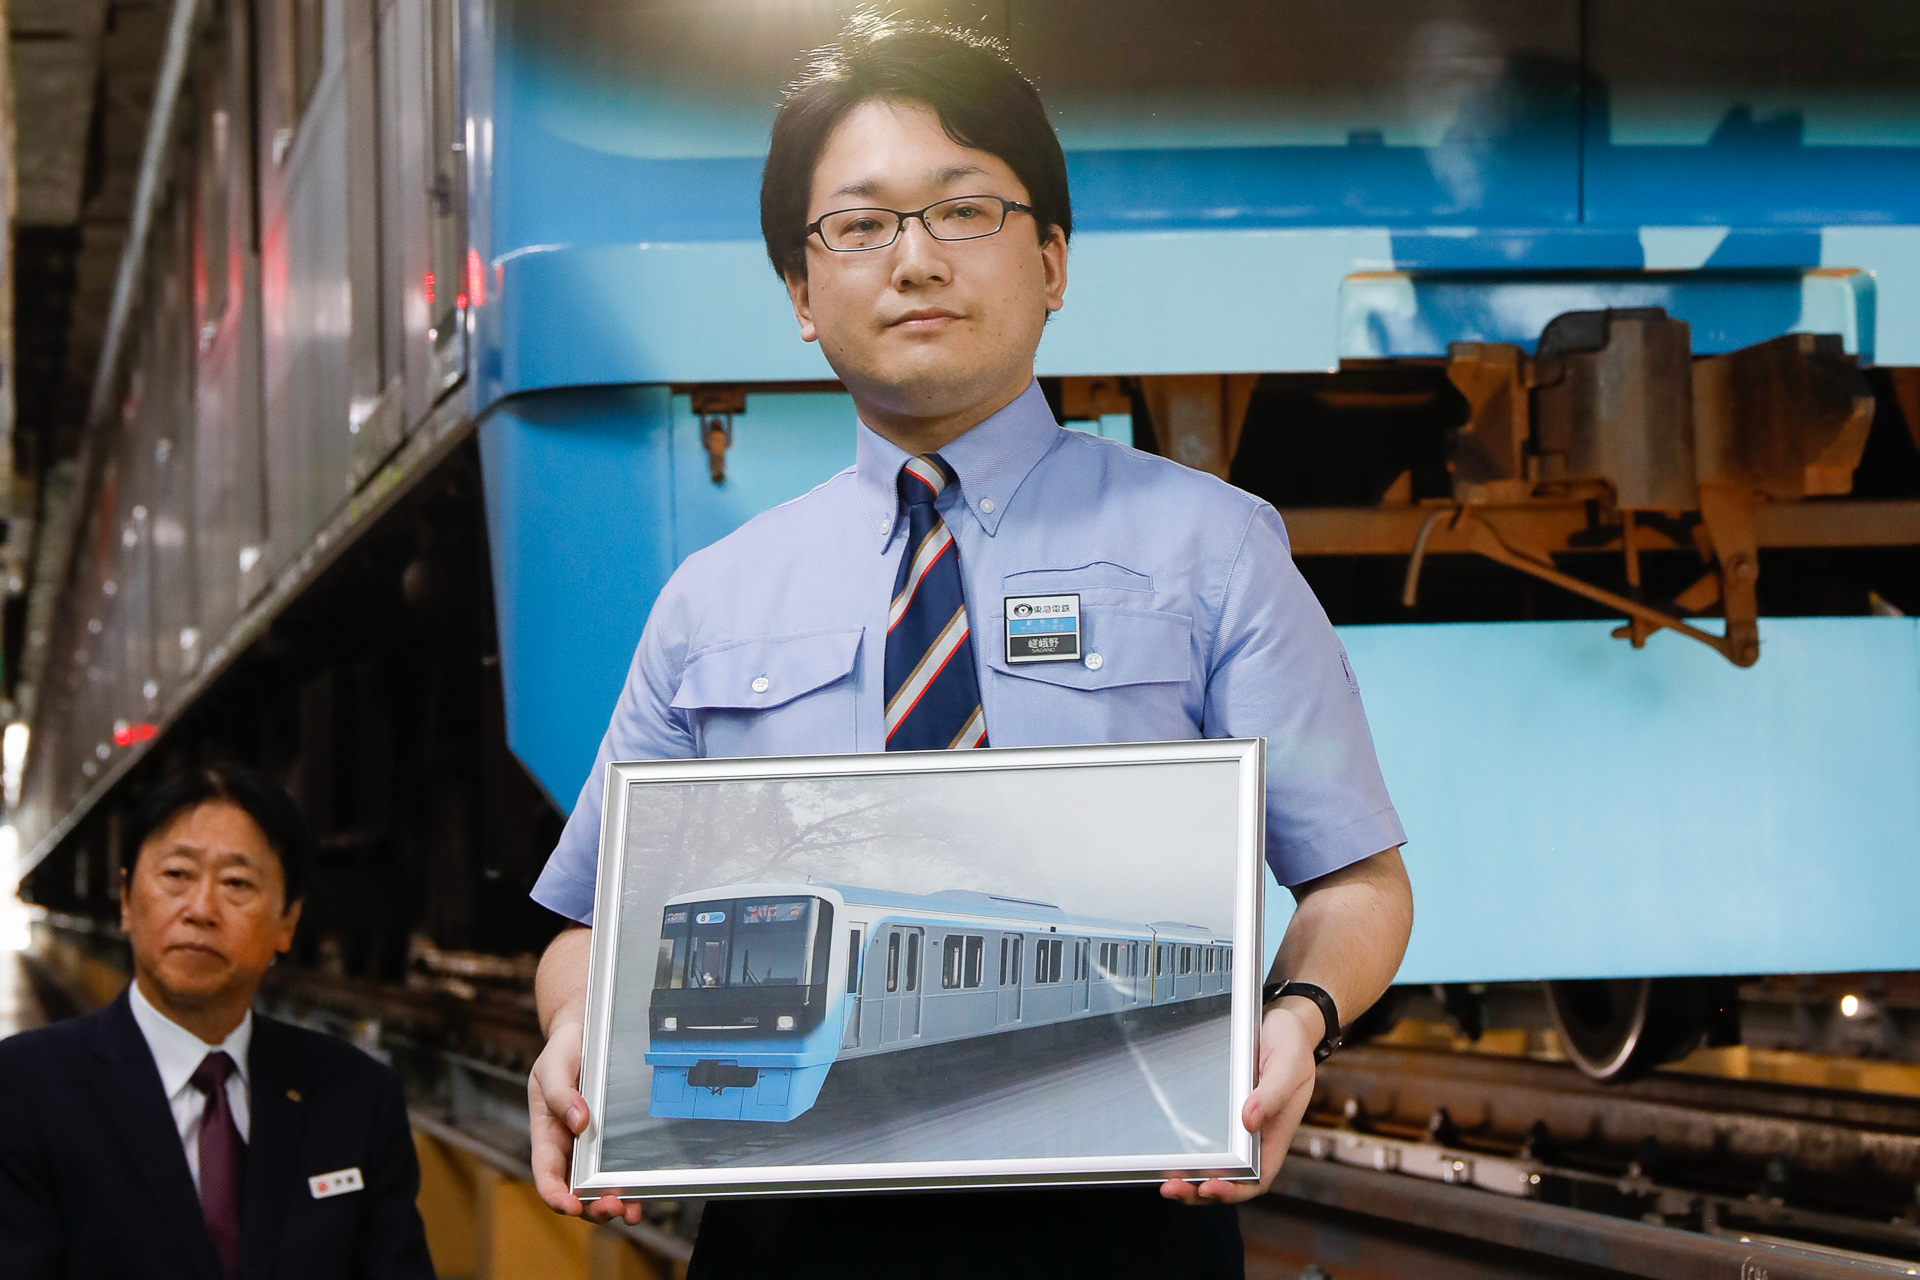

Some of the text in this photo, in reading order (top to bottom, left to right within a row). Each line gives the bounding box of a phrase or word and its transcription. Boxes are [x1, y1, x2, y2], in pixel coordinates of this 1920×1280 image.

[1033, 604, 1071, 613] 東急電鉄
[1027, 637, 1059, 649] 嵯峨野
[700, 914, 706, 922] 8
